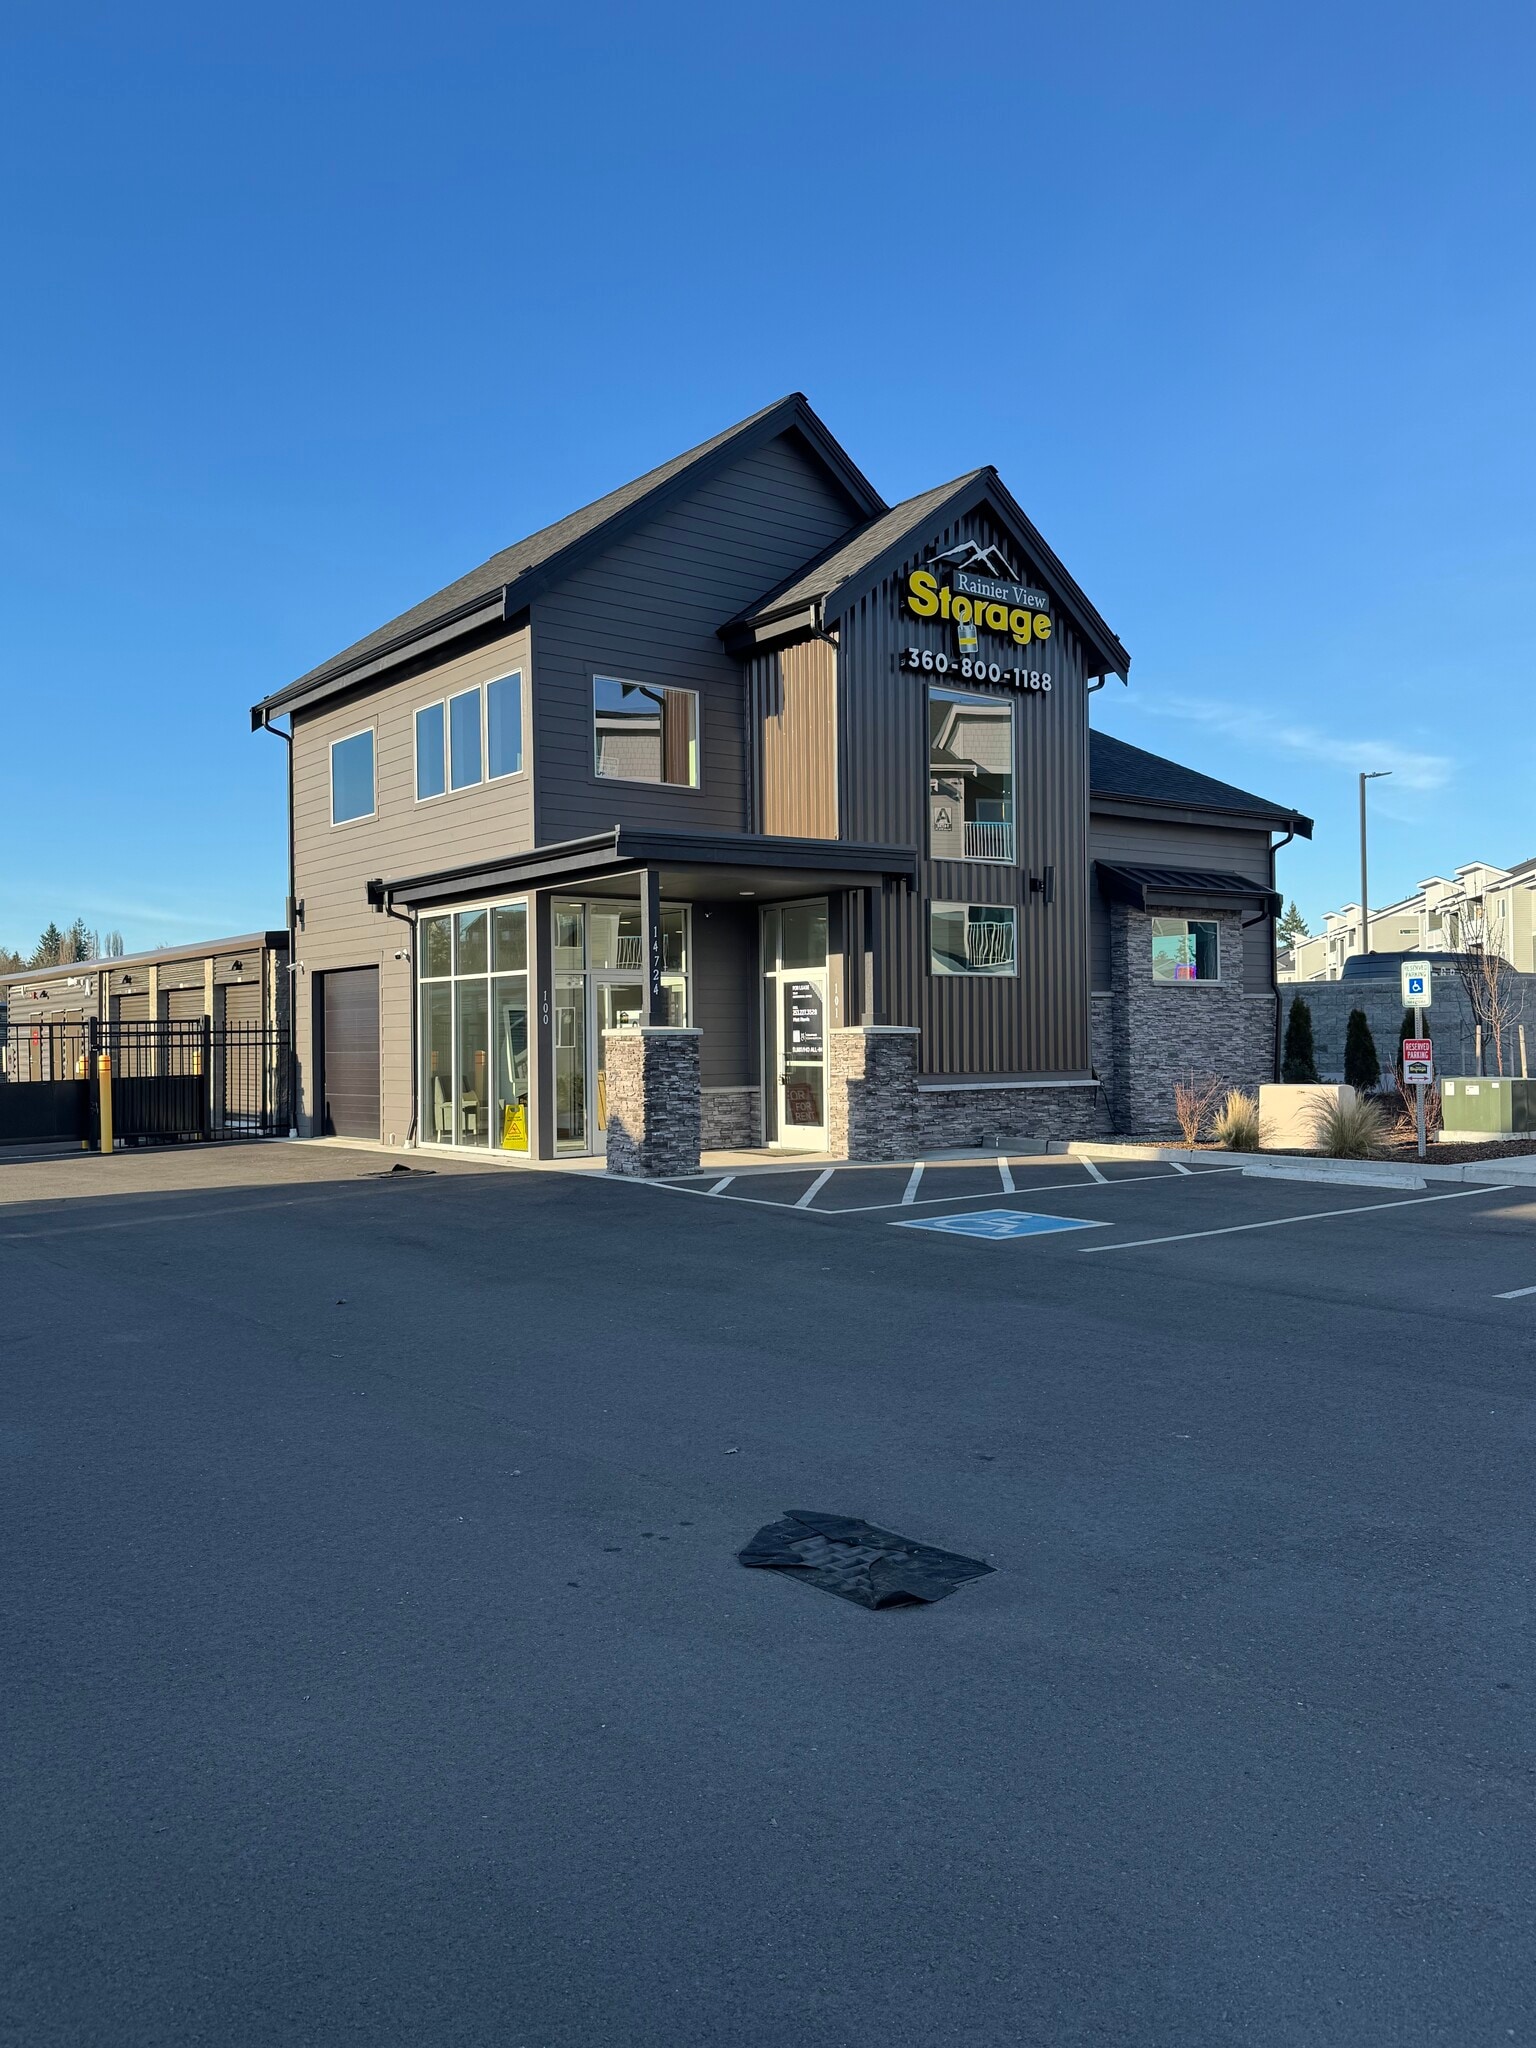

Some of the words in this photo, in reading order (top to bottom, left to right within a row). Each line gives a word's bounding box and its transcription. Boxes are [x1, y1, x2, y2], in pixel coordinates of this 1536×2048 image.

[958, 573, 1009, 601] Rainier
[1012, 586, 1046, 609] View
[907, 570, 1053, 645] Storage
[908, 647, 1053, 692] 360-800-1188
[652, 925, 660, 995] 14724
[1406, 1042, 1430, 1051] RESERVED
[1407, 1051, 1429, 1059] PARKING
[795, 1102, 812, 1111] FOR
[795, 1111, 815, 1121] RENT
